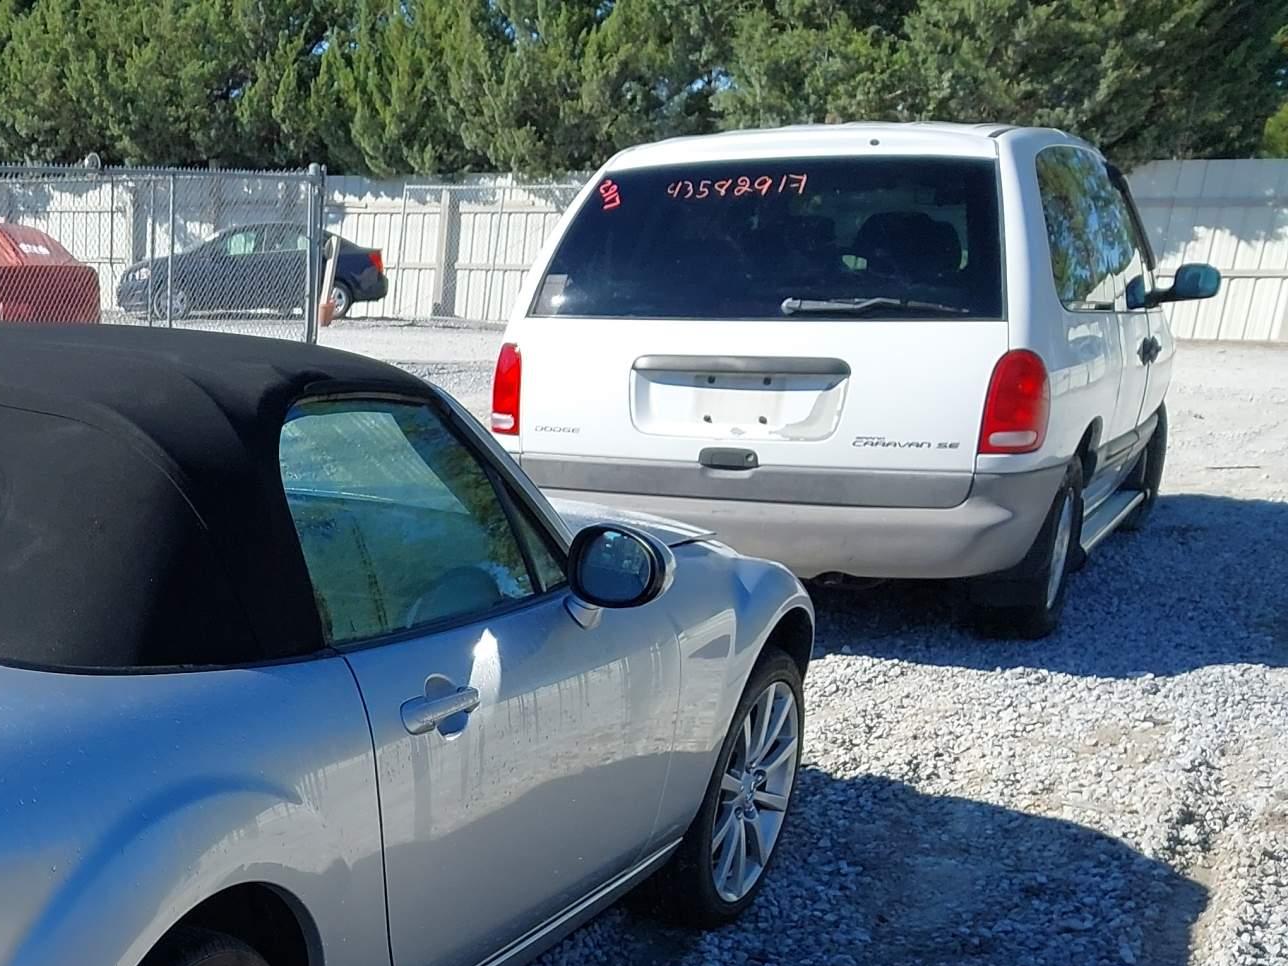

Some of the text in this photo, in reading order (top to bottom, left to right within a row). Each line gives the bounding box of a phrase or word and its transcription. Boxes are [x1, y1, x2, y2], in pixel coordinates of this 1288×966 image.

[667, 174, 807, 199] 43582917
[534, 425, 581, 434] DODGE
[852, 440, 932, 449] CARAVAN
